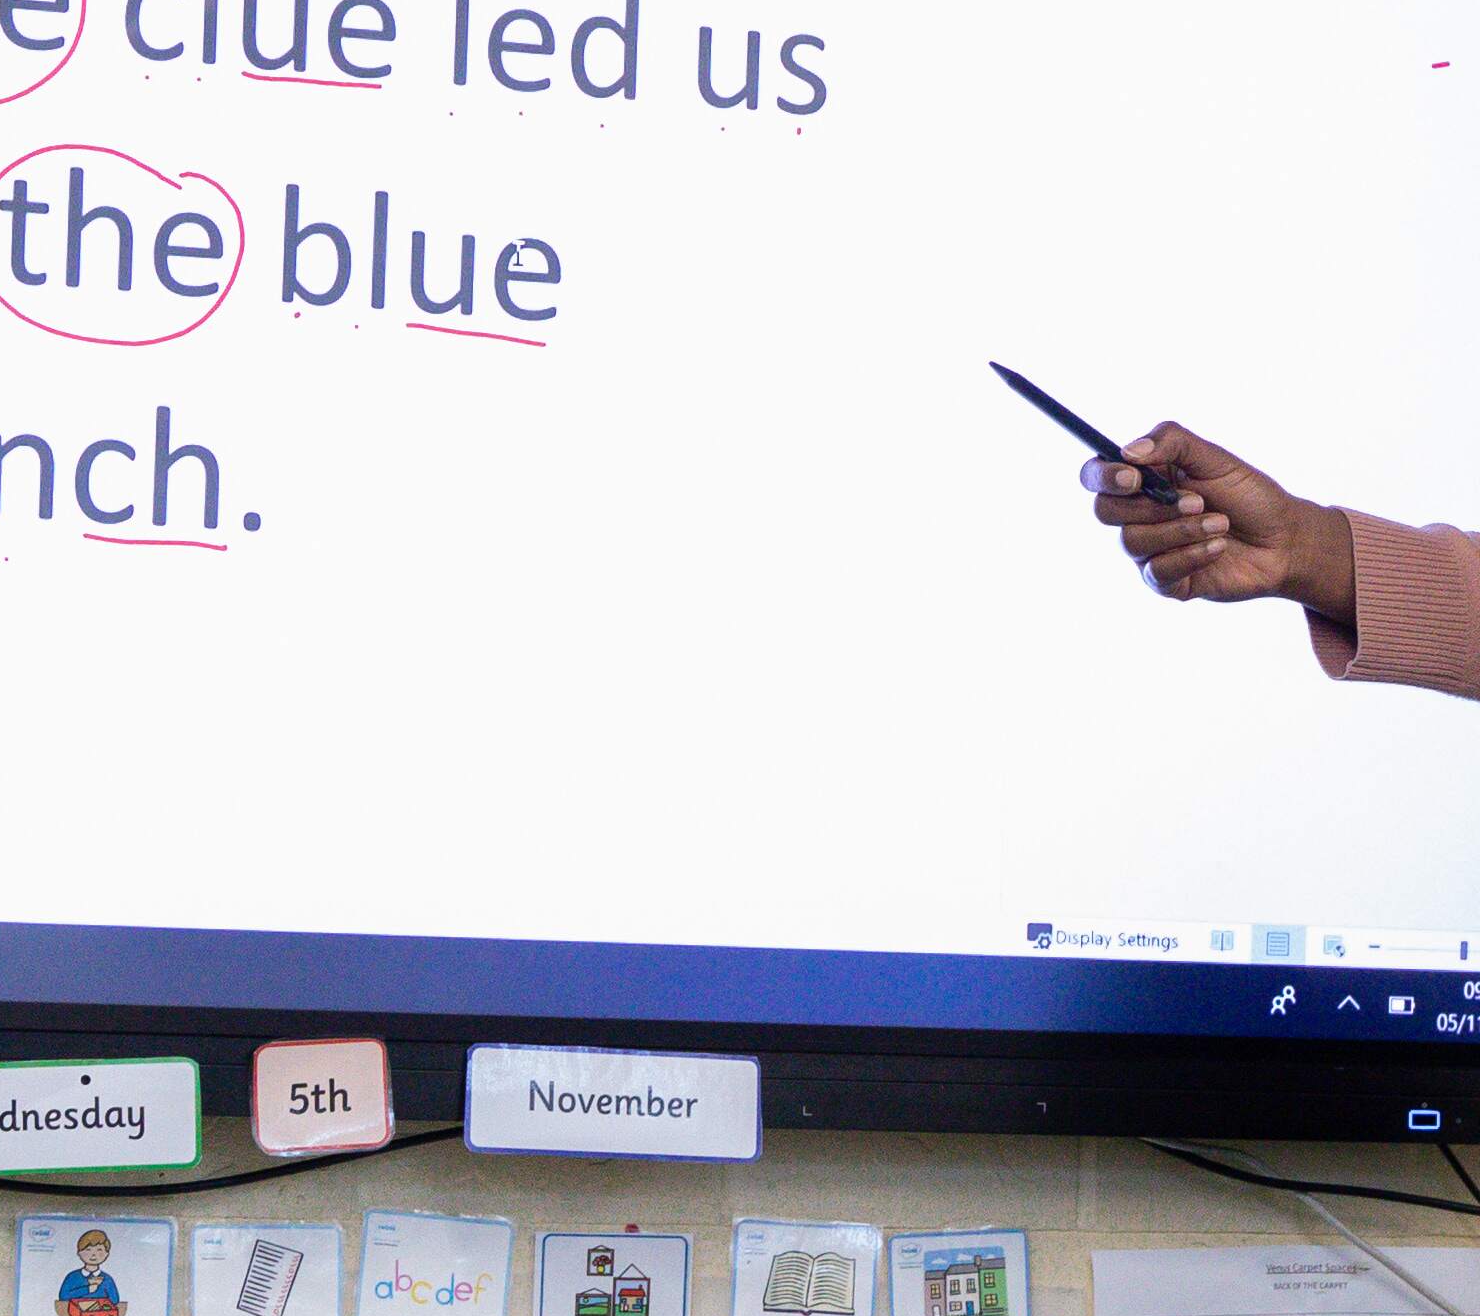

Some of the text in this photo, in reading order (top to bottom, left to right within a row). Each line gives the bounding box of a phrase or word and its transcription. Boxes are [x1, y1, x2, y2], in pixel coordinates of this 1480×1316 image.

[697, 25, 828, 116] us
[0, 166, 223, 297] the
[281, 183, 562, 322] blue
[1055, 930, 1179, 953] Display Settings
[289, 1078, 352, 1115] 5th
[529, 1080, 699, 1118] November
